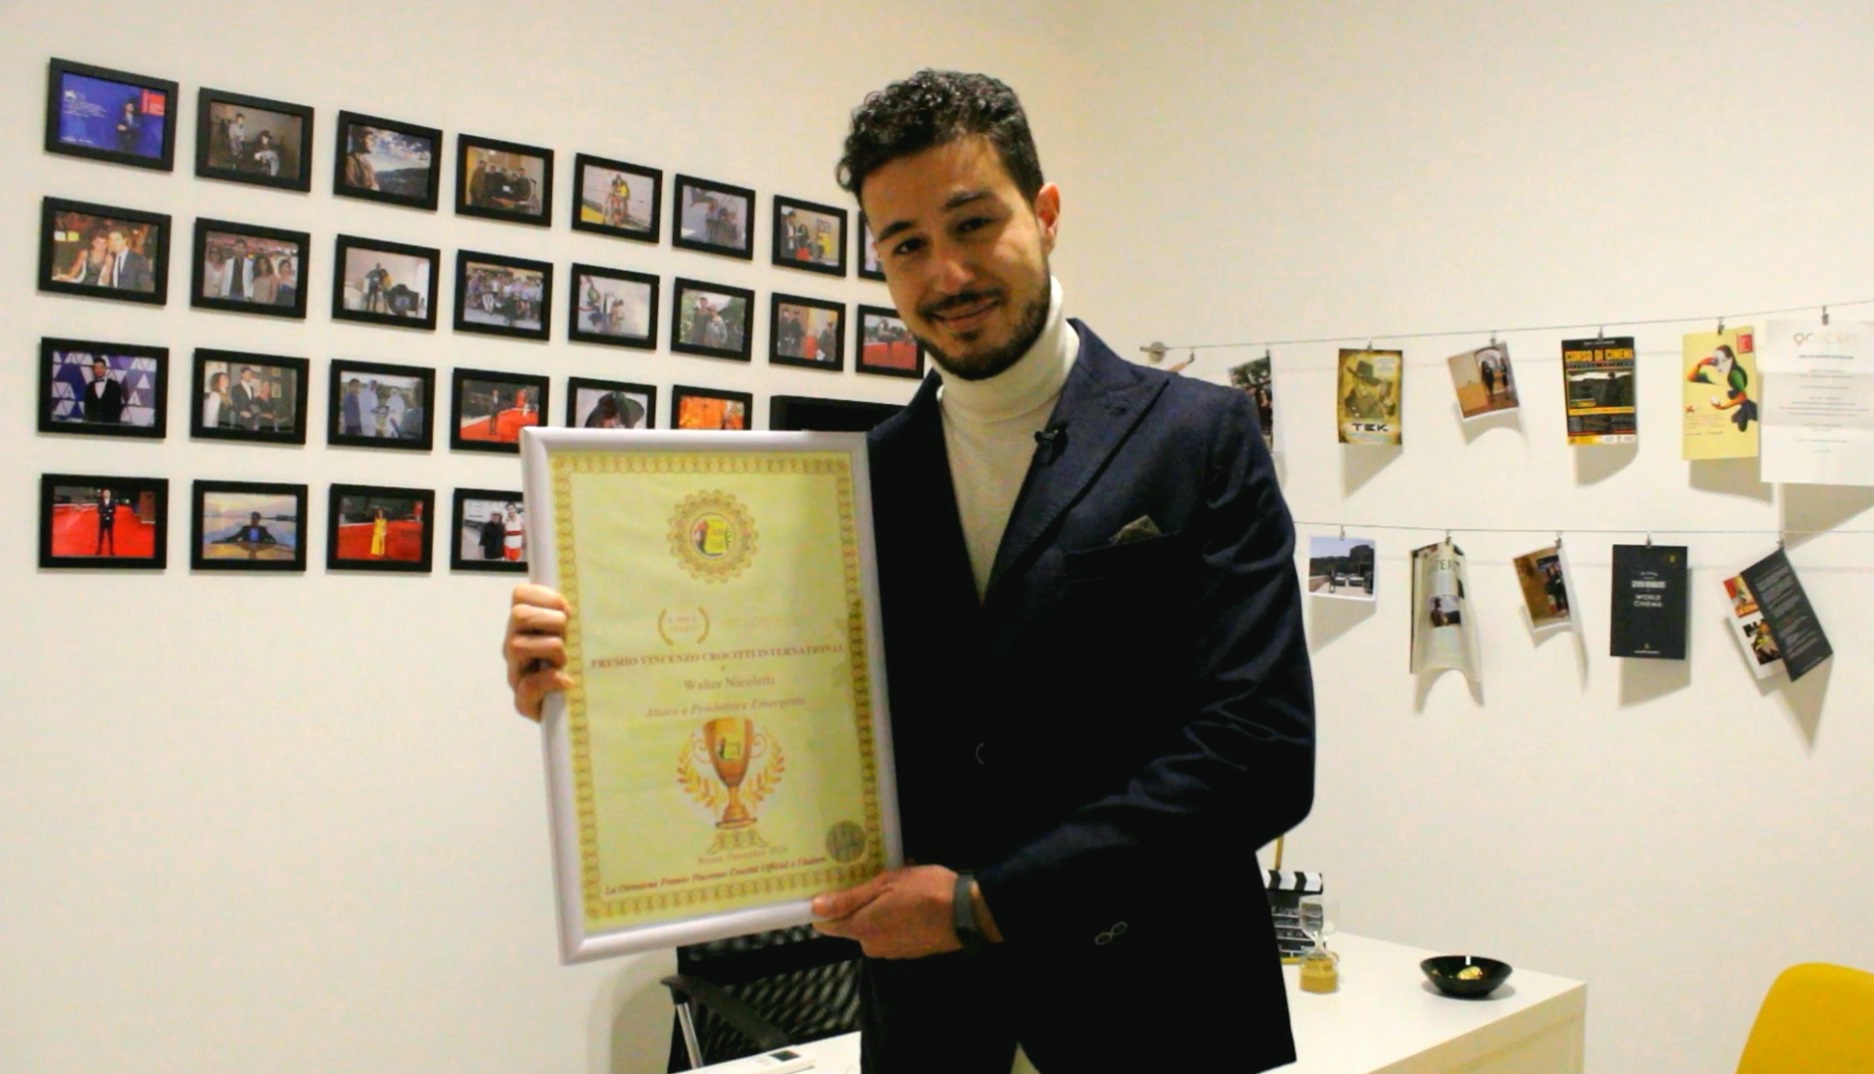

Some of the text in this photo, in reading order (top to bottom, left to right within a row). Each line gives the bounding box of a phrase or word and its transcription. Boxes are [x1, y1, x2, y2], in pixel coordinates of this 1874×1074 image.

[1352, 423, 1389, 432] TEK
[591, 654, 638, 668] PREMIO
[640, 651, 699, 665] VINCENZO
[757, 644, 845, 659] INTERNATIONAL
[684, 675, 775, 692] Walter Nicoletti
